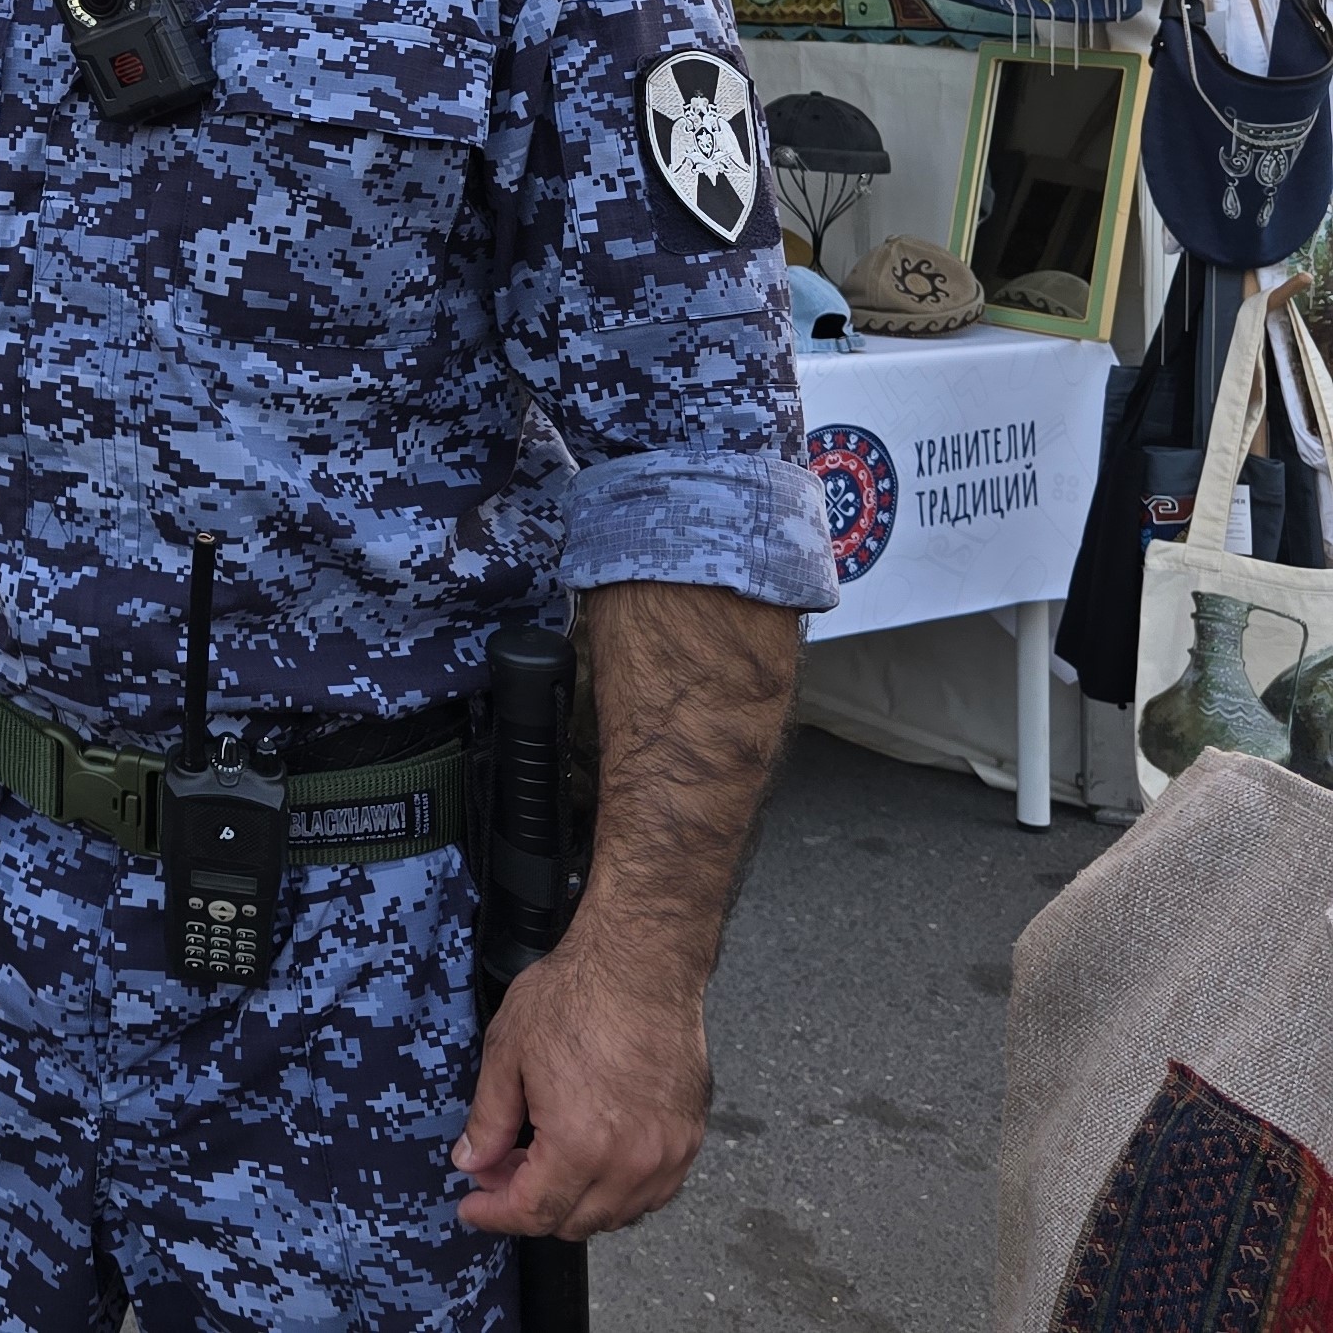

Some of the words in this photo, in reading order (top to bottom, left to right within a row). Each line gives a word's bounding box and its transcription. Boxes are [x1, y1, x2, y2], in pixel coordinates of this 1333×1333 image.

[915, 419, 1036, 478] ХРАНИТЕЛИ
[915, 462, 1038, 528] ТРАДИЦИЙ
[288, 801, 406, 838] BLACKHAWK!
